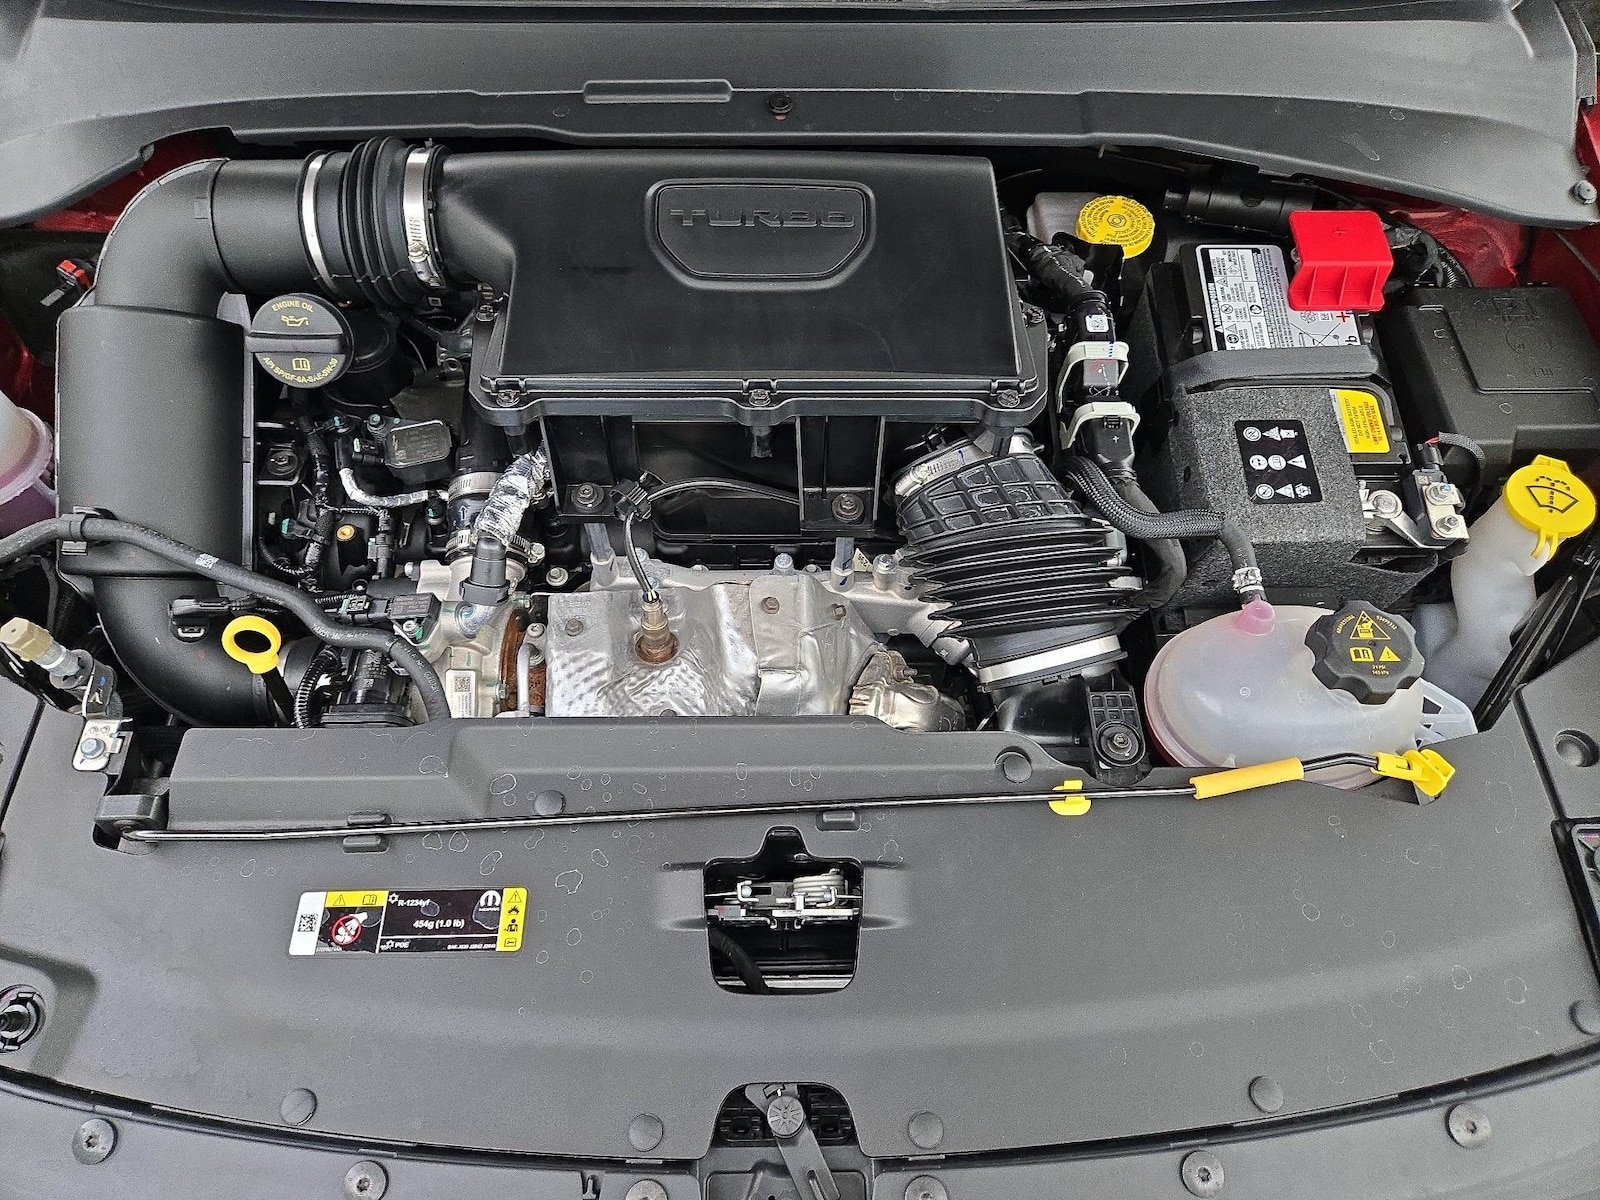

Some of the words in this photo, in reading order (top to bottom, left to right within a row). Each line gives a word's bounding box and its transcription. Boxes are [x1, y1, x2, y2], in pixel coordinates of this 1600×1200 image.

[669, 207, 855, 227] TURBO
[271, 300, 300, 312] ENGINE
[301, 302, 314, 312] OIL
[262, 357, 274, 369] API
[397, 899, 431, 907] R-1234yf
[413, 919, 434, 930] 454g
[435, 919, 452, 929] (1.0
[452, 918, 465, 929] lb)
